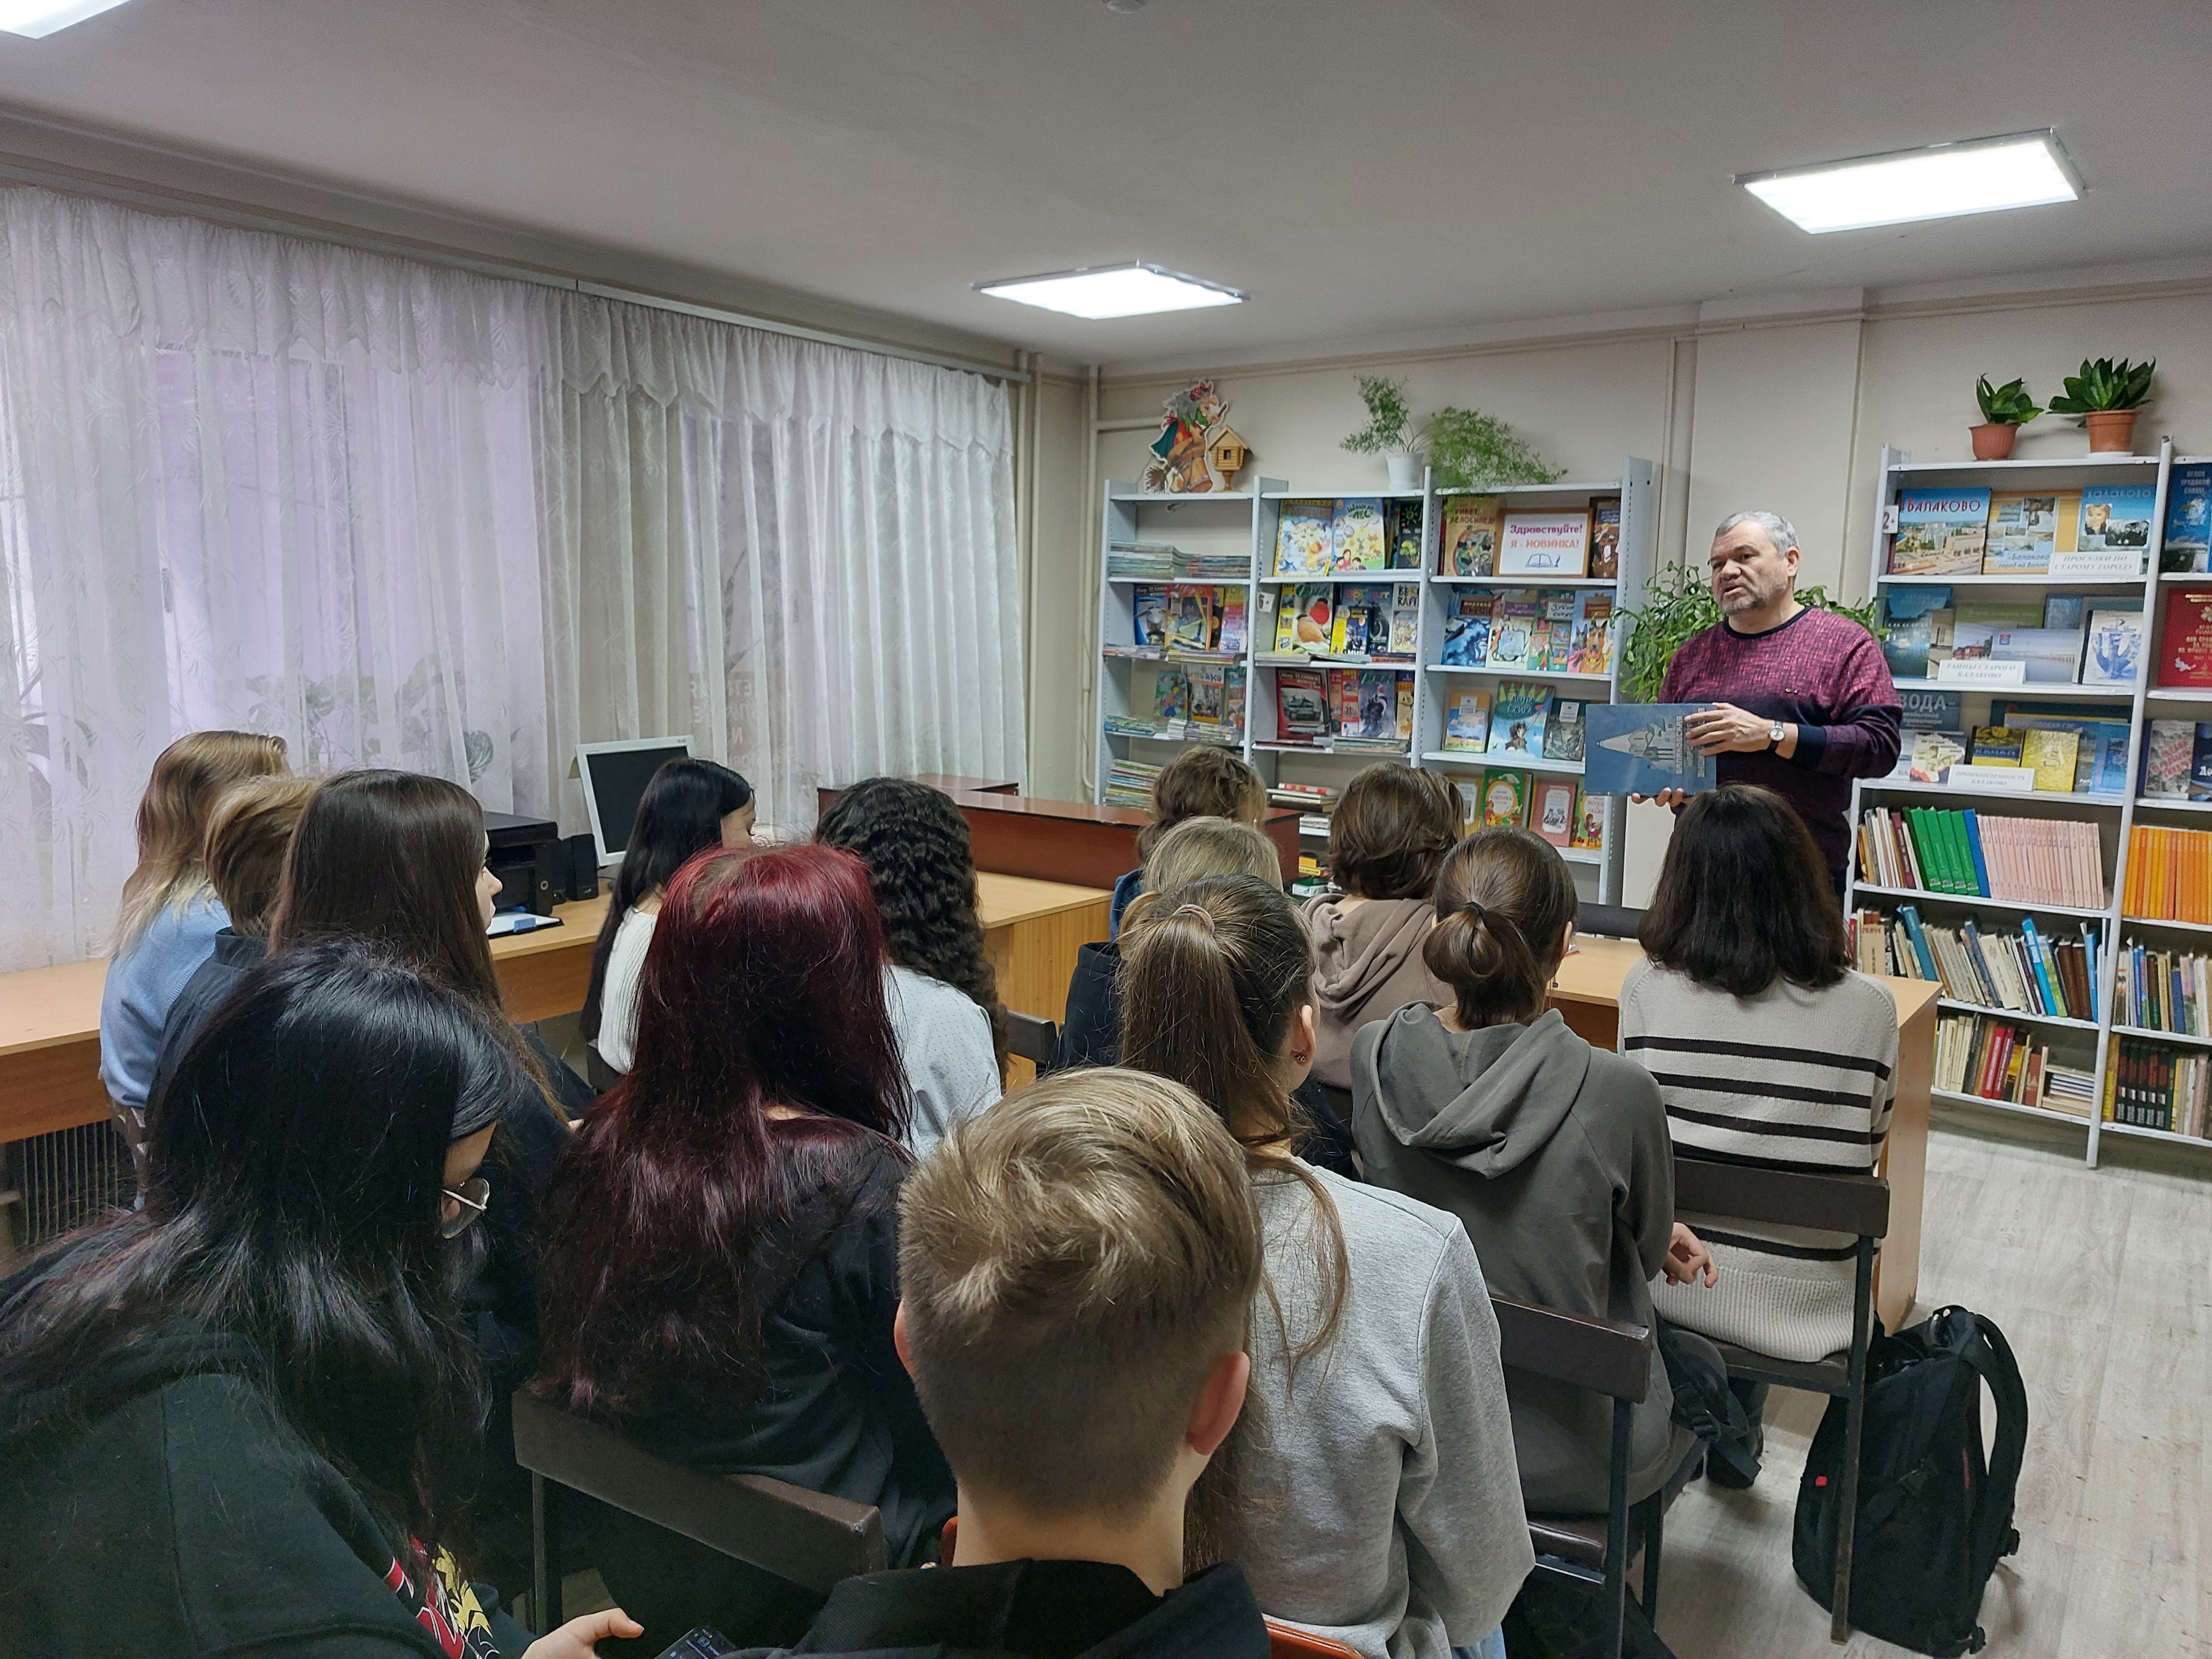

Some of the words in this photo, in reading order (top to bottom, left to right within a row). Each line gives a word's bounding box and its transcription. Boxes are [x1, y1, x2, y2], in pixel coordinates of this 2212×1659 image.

[1907, 498, 1980, 513] БАЛАКОВО
[1510, 524, 1582, 536] Здравствуйте!
[1510, 540, 1517, 548] Я
[1526, 540, 1579, 548] НОВИНКА!
[1900, 694, 1947, 712] ВОДА
